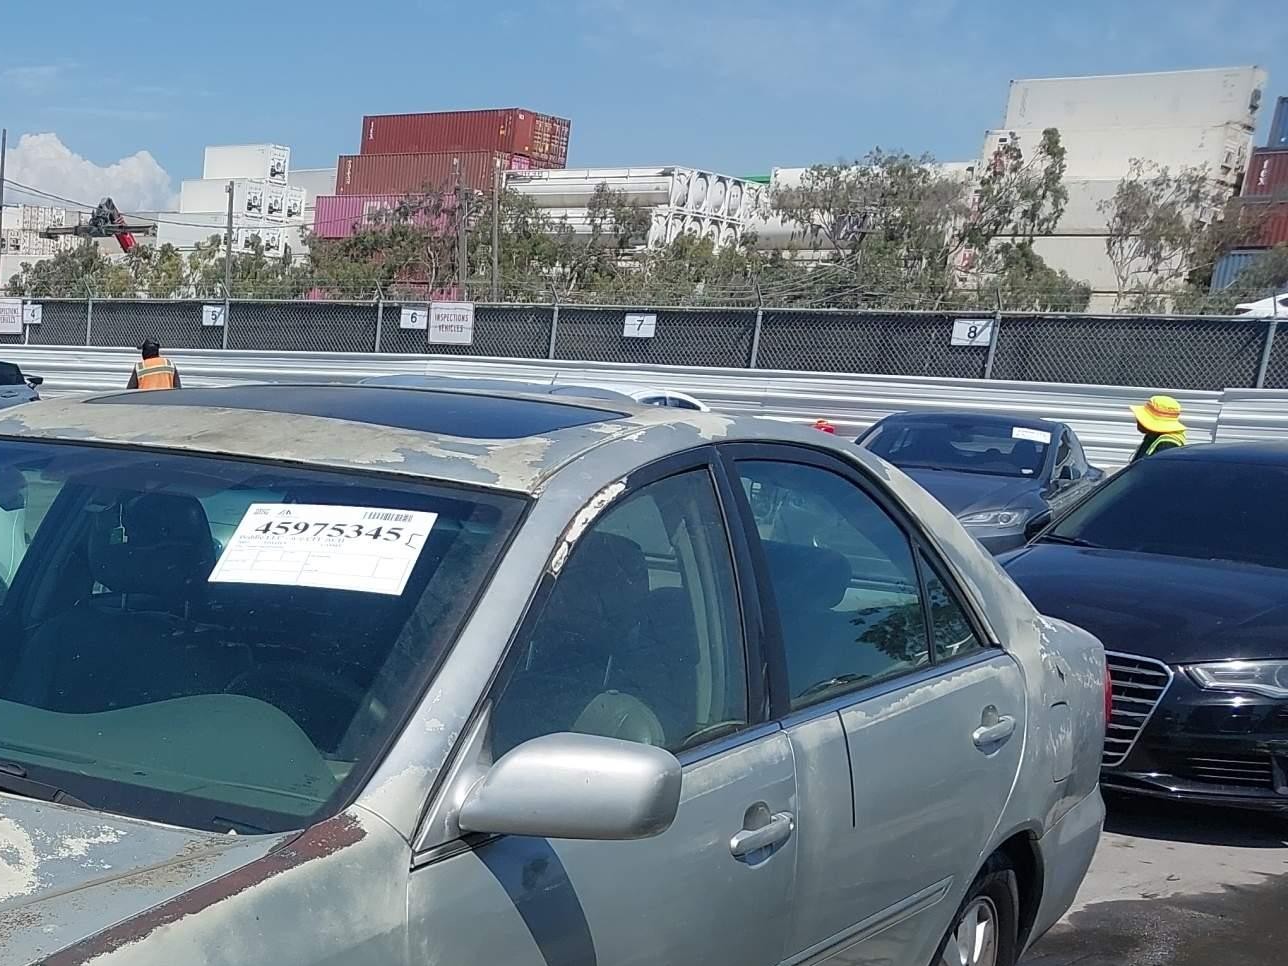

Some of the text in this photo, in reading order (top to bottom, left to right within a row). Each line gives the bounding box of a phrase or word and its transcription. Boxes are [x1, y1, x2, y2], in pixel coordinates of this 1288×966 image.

[410, 312, 418, 324] 6
[434, 313, 469, 323] INSPECTIONS
[438, 324, 464, 333] VEHICLES
[636, 319, 645, 332] 7
[967, 325, 978, 339] 8
[254, 520, 404, 543] 45975345
